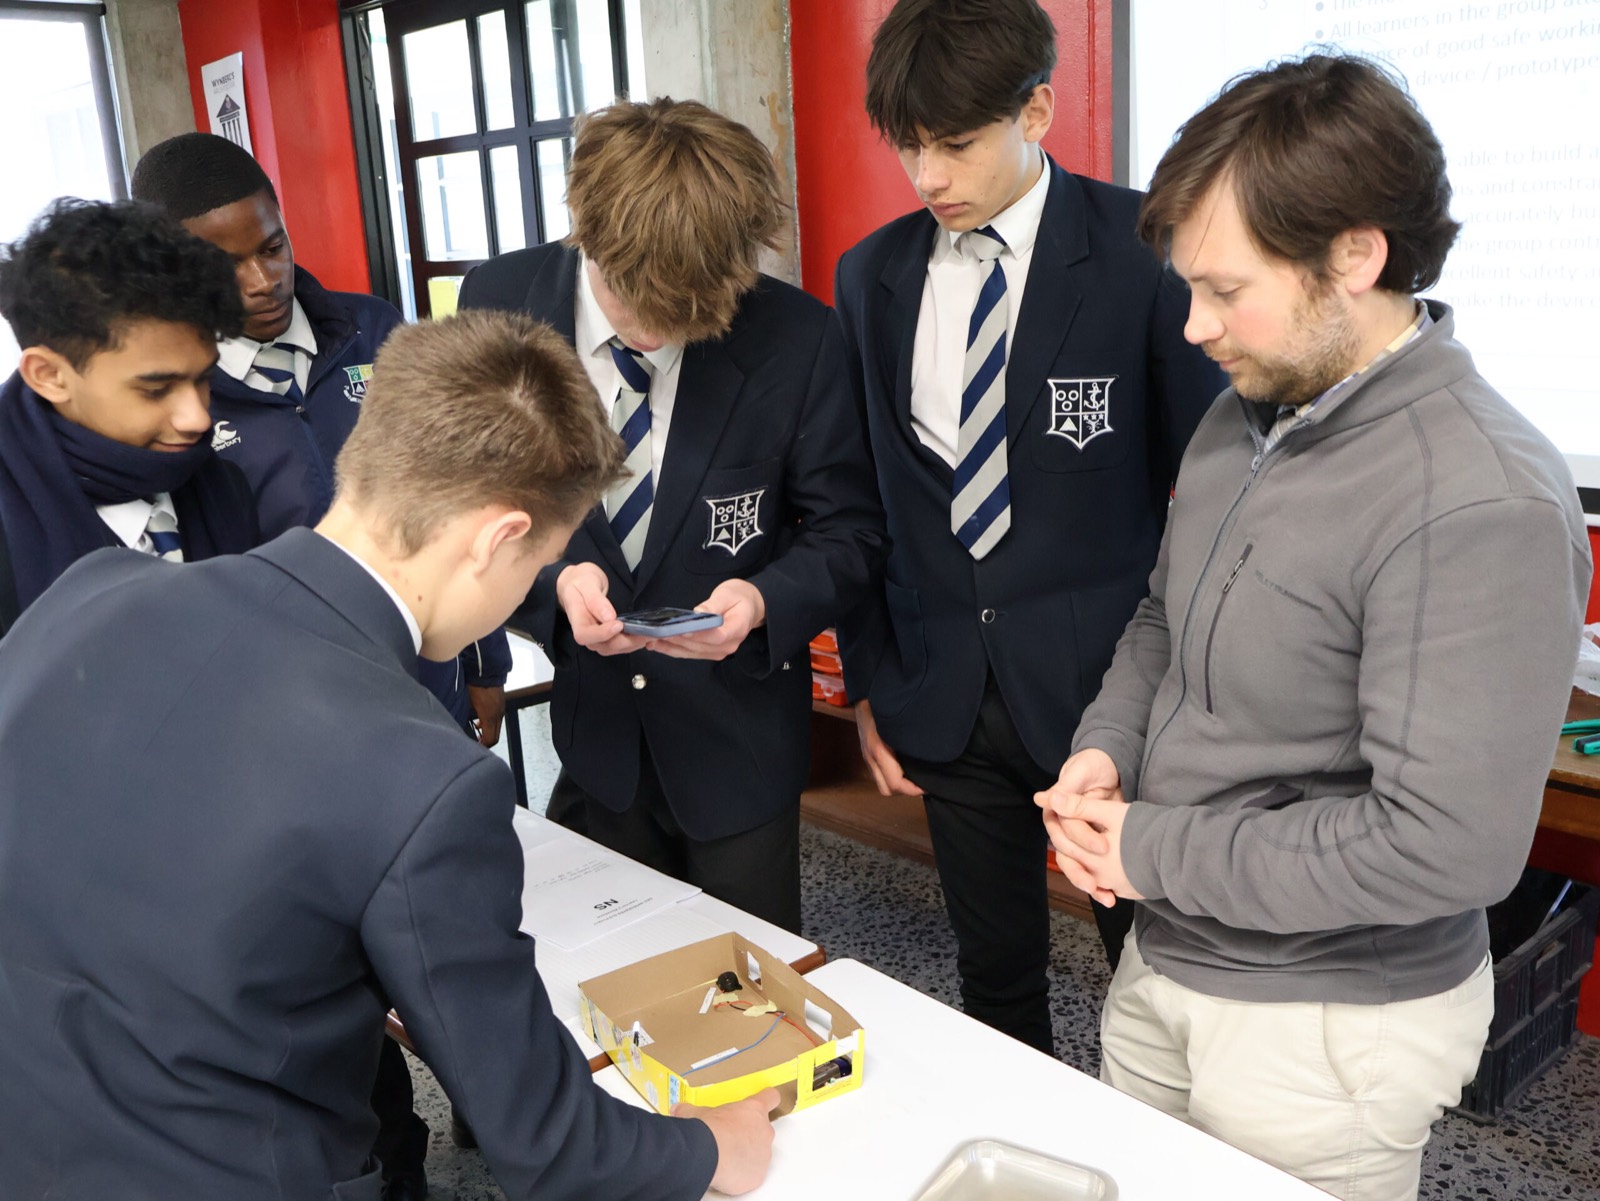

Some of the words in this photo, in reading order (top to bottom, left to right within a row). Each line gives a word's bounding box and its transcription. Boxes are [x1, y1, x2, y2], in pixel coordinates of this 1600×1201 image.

[1329, 20, 1351, 40] All
[1357, 14, 1430, 36] learners
[1436, 9, 1453, 25] in
[1460, 4, 1490, 21] the
[1496, 0, 1555, 21] group
[1413, 40, 1430, 58] of
[1437, 33, 1485, 59] good
[1492, 28, 1531, 48] safe
[1415, 68, 1476, 86] device
[1497, 53, 1600, 82] prototype
[1457, 150, 1497, 168] able
[1504, 150, 1525, 165] to
[1530, 143, 1581, 162] build
[1480, 176, 1515, 196] and
[1443, 264, 1511, 280] xcellent
[1519, 263, 1579, 283] safety
[1499, 292, 1531, 308] the
